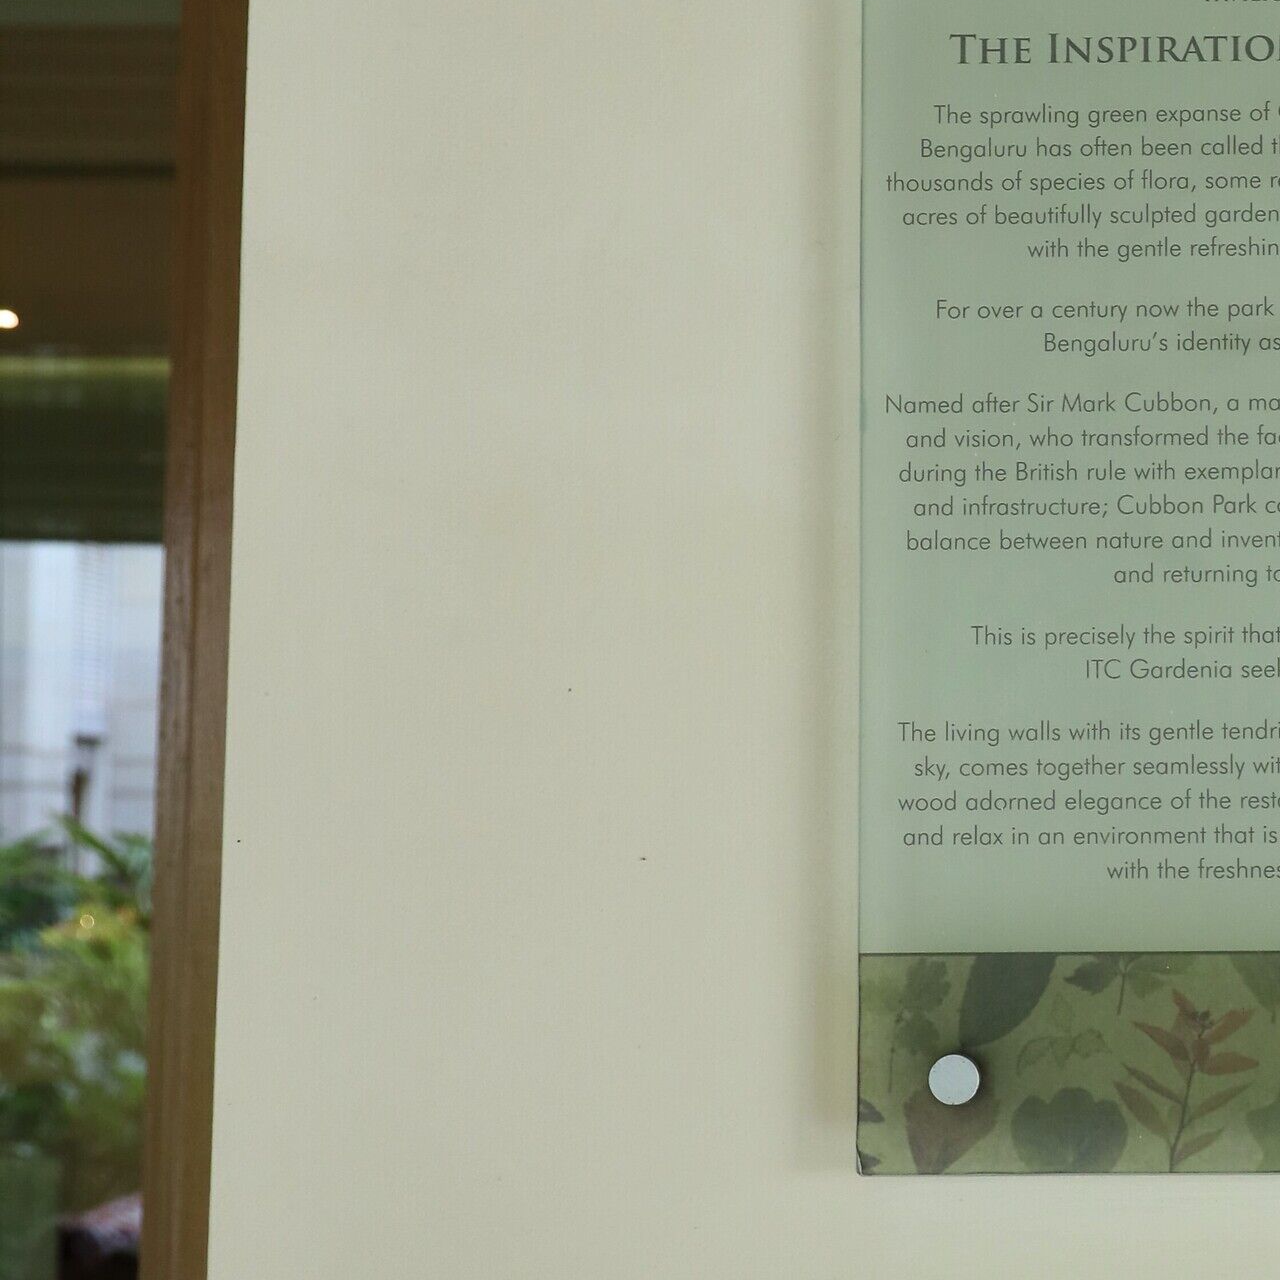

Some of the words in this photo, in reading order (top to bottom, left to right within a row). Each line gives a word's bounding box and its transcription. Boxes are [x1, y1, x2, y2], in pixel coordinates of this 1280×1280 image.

[949, 33, 1032, 65] THE
[933, 103, 972, 125] The
[979, 102, 1079, 129] sprawling
[1087, 109, 1147, 128] green
[1155, 109, 1242, 128] expanse
[1249, 100, 1271, 122] of
[885, 171, 994, 192] thousands
[1001, 170, 1023, 192] of
[1029, 172, 1106, 196] species
[1113, 168, 1135, 191] of
[1140, 168, 1196, 193] flora,
[1205, 175, 1261, 189] some
[1027, 236, 1069, 258] with
[1077, 236, 1109, 258] the
[1117, 235, 1182, 263] gentle
[936, 299, 971, 320] For
[977, 305, 1024, 320] over
[1030, 305, 1043, 320] a
[1052, 300, 1128, 323] century
[1136, 304, 1180, 318] now
[1186, 296, 1219, 318] the
[1227, 295, 1275, 323] park
[1177, 330, 1251, 356] identity
[885, 392, 963, 414] Named
[972, 391, 1021, 414] after
[1027, 392, 1055, 414] Sir
[1061, 391, 1116, 413] Mark
[1124, 390, 1218, 415] Cubbon,
[1226, 398, 1239, 412] a
[905, 427, 946, 449] and
[954, 429, 1021, 451] vision,
[1029, 426, 1074, 448] who
[1081, 424, 1209, 447] transformed
[1217, 424, 1249, 446] the
[913, 494, 954, 517] and
[962, 494, 1108, 519] infrastructure;
[1116, 492, 1204, 515] Cubbon
[1213, 492, 1257, 515] Park
[1113, 562, 1154, 584] and
[1163, 564, 1258, 588] returning
[970, 625, 1013, 647] This
[1021, 626, 1036, 646] is
[1044, 623, 1136, 651] precisely
[1143, 623, 1176, 645] the
[1183, 626, 1235, 650] spirit
[1086, 658, 1121, 680] ITC
[1129, 657, 1232, 679] Gardenia
[897, 721, 936, 743] The
[945, 720, 1000, 748] living
[1008, 720, 1061, 742] walls
[1068, 719, 1111, 741] with
[1120, 721, 1141, 741] its
[1148, 719, 1214, 746] gentle
[914, 754, 950, 782] sky,
[959, 762, 1029, 777] comes
[1036, 754, 1126, 782] together
[1133, 752, 1246, 780] seamlessly
[1106, 858, 1149, 880] with
[1156, 858, 1190, 880] the
